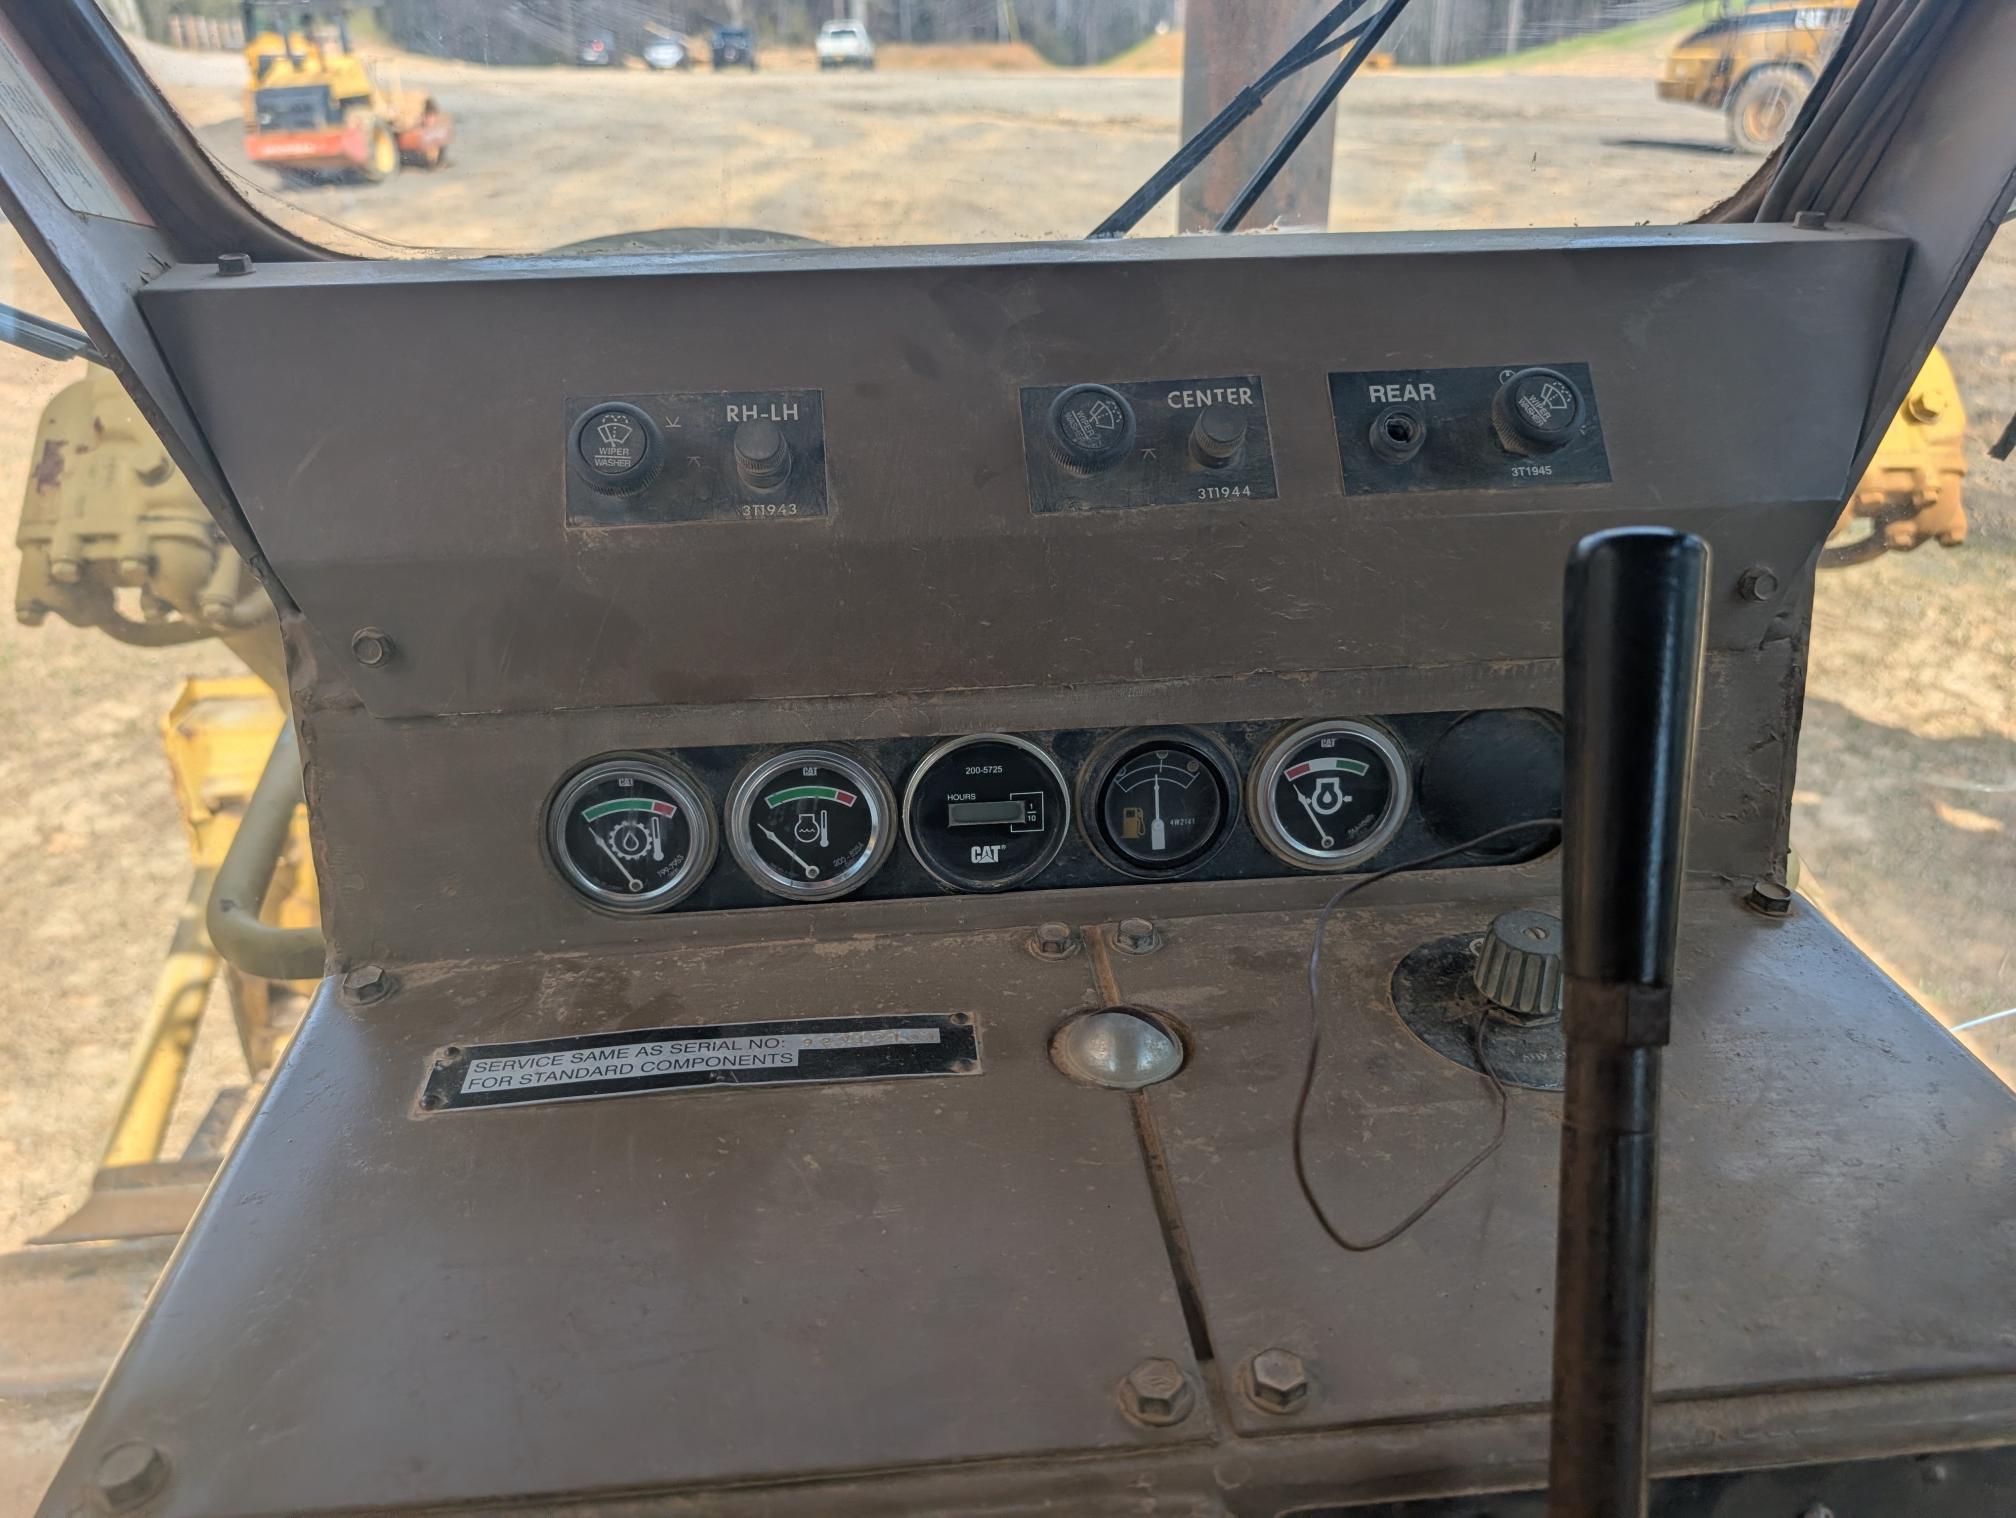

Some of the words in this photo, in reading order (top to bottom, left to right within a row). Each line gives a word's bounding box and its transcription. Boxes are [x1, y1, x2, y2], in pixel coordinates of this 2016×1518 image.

[1167, 387, 1254, 409] CENTER
[1369, 383, 1436, 402] REAR
[727, 403, 799, 422] RH-LH
[1518, 398, 1545, 427] WASHER
[1528, 394, 1551, 420] WIPER
[1076, 410, 1095, 438] WIPER
[599, 447, 630, 456] WIPER
[595, 458, 631, 467] WASHER
[1511, 465, 1553, 477] 3T1945
[1198, 485, 1251, 499] 3T1944
[742, 503, 798, 516] 3T1943
[1320, 738, 1336, 748] CAT
[802, 766, 818, 776] CAT
[965, 765, 1003, 775] 200-5725
[947, 793, 977, 801] HOURS
[971, 845, 1001, 864] CAT
[474, 1055, 565, 1073] SERVICE
[570, 1046, 629, 1064] SAME
[635, 1043, 663, 1056] AS
[669, 1038, 743, 1056] SERIAL
[748, 1037, 786, 1049] NO:
[468, 1076, 513, 1090] FOR
[518, 1063, 634, 1085] STANDARD
[641, 1052, 794, 1073] COMPONENTS
